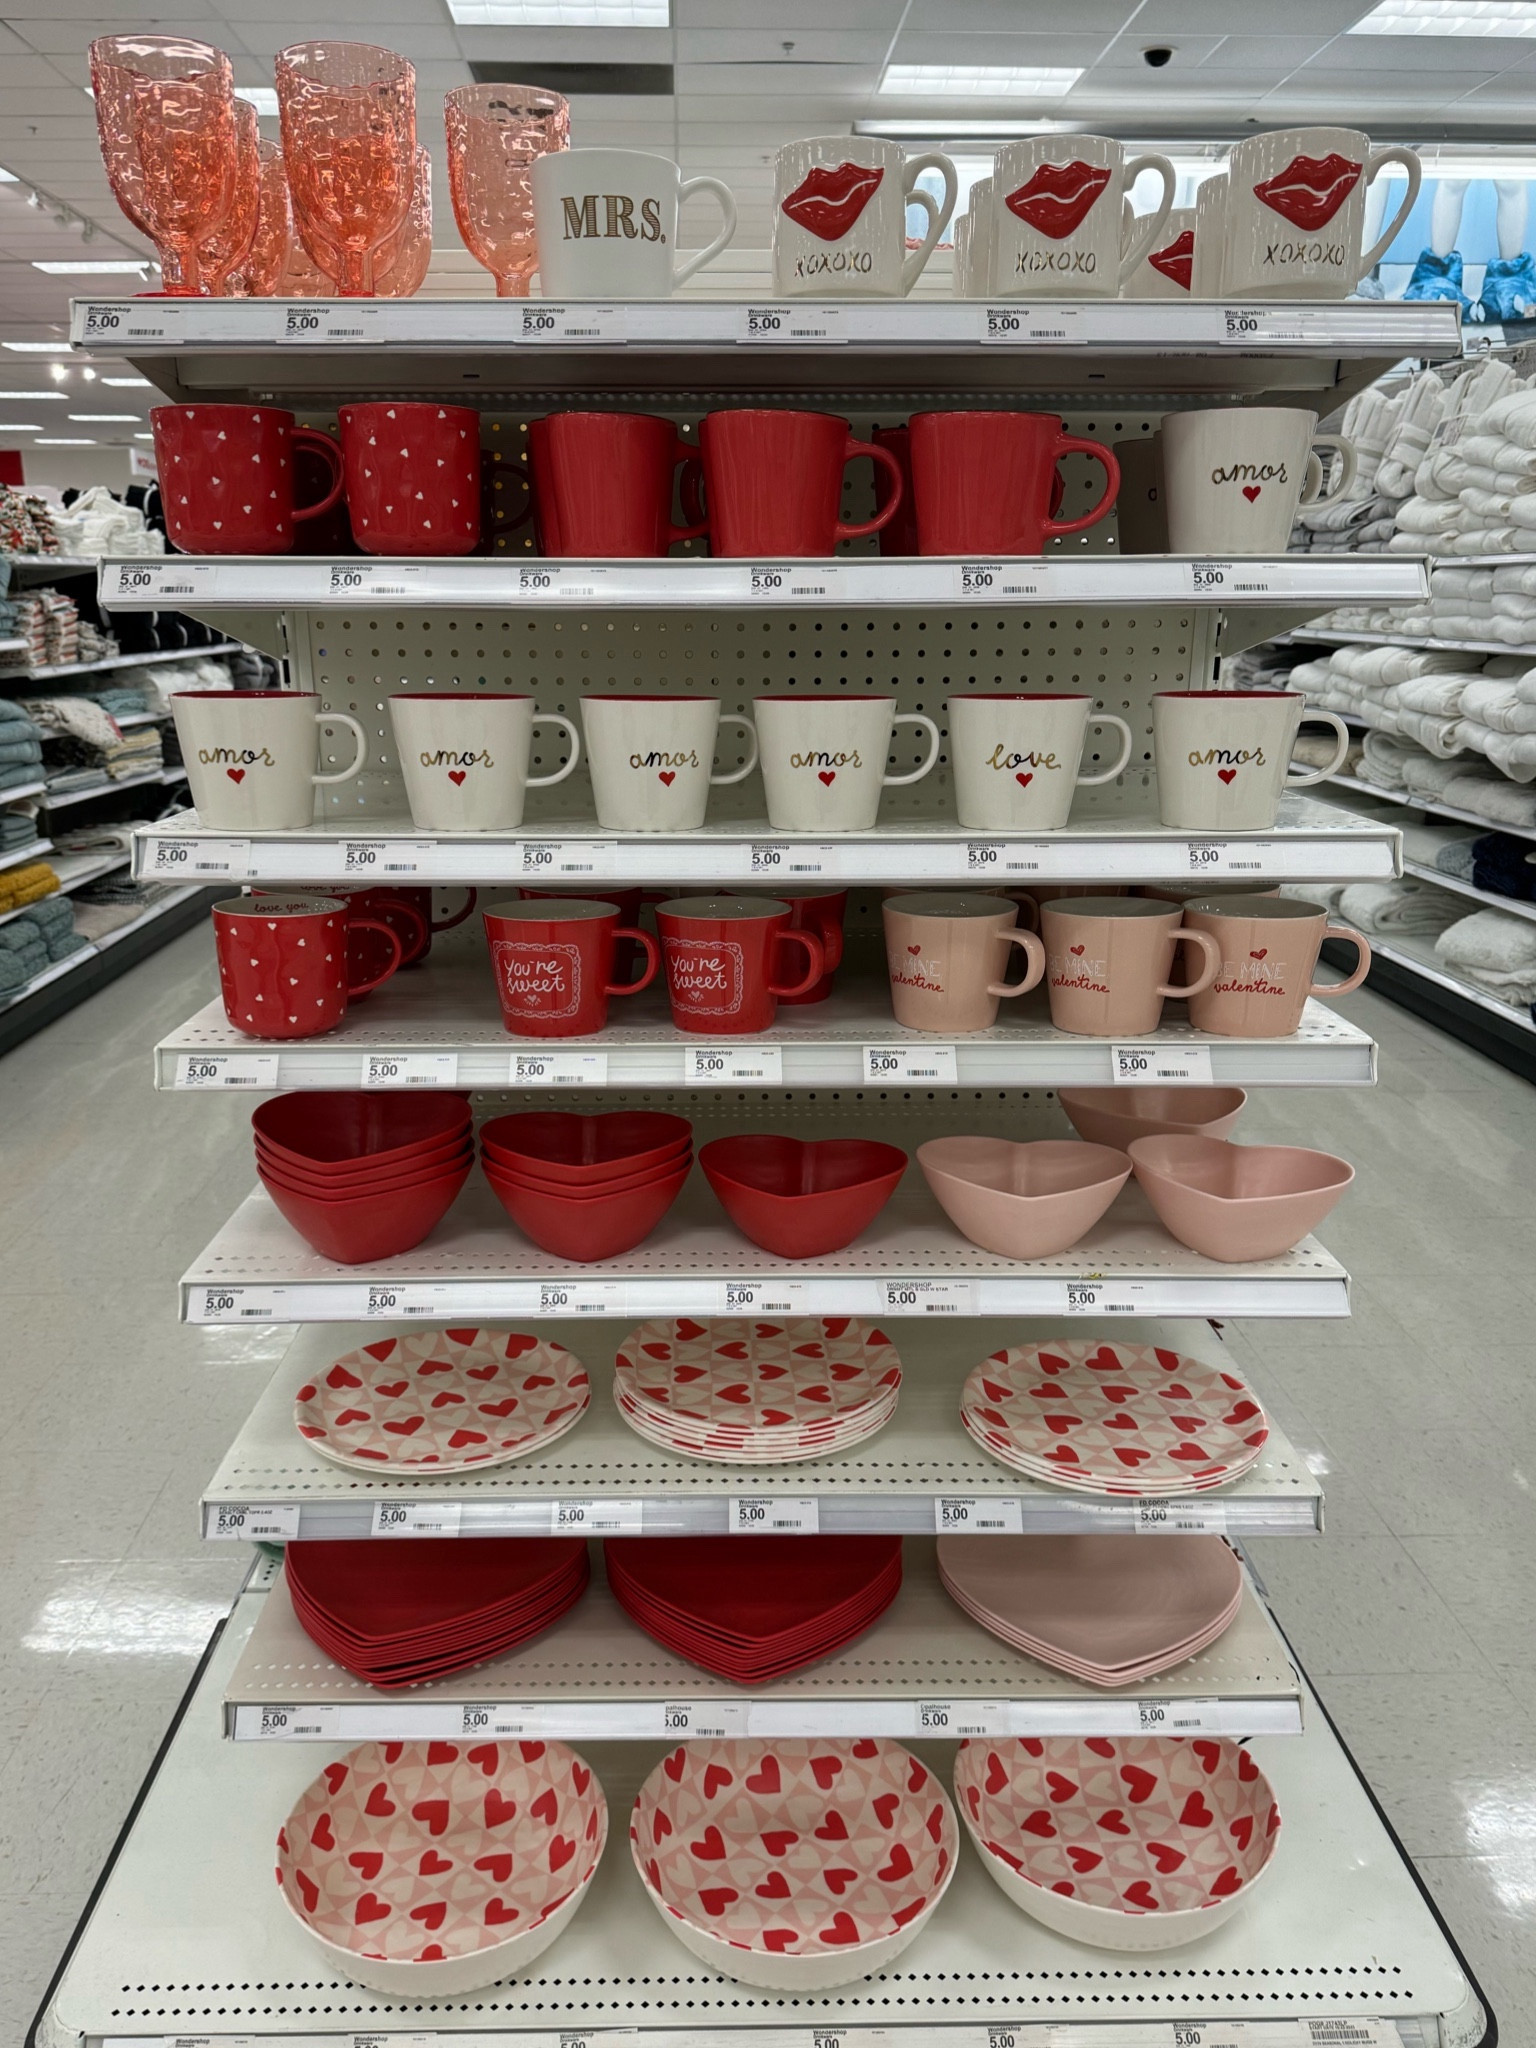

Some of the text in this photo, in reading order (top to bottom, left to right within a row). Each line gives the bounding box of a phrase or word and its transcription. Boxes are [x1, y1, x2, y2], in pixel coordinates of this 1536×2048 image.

[560, 195, 666, 244] MRS.
[1262, 244, 1346, 266] XOXOXO
[794, 252, 872, 277] XOXOXO
[1015, 251, 1096, 273] XOXOXO
[88, 305, 131, 313] Wondershop
[87, 316, 120, 328] 5.00
[287, 317, 319, 329] 5.00
[523, 317, 555, 329] 5.00
[748, 317, 781, 330] 5.00
[988, 318, 1020, 330] 5.00
[1226, 319, 1258, 331] 5.00
[1212, 462, 1288, 484] amor
[120, 573, 151, 585] 5.00
[331, 574, 362, 586] 5.00
[520, 576, 551, 588] 5.00
[751, 575, 782, 587] 5.00
[962, 574, 993, 586] 5.00
[1193, 572, 1224, 584] 5.00
[199, 748, 275, 766] amor
[420, 748, 494, 767] amor
[630, 750, 699, 768] amor
[790, 750, 862, 768] amor
[986, 744, 1062, 769] love
[1190, 747, 1265, 766] amor
[157, 850, 188, 862] 5.00
[346, 852, 377, 864] 5.00
[523, 852, 553, 864] 5.00
[751, 853, 781, 865] 5.00
[968, 851, 997, 862] 5.00
[1189, 851, 1218, 862] 5.00
[254, 903, 283, 913] love
[504, 959, 564, 977] You're
[671, 955, 726, 973] You're
[1065, 957, 1107, 977] MINE
[1240, 961, 1287, 980] MINE
[507, 974, 566, 994] sweet
[674, 971, 728, 989] sweet
[1052, 974, 1110, 992] valentine
[1213, 978, 1286, 995] valentine
[516, 1064, 545, 1075] 5.00
[696, 1058, 724, 1070] 5.00
[870, 1058, 898, 1069] 5.00
[1119, 1058, 1148, 1070] 5.00
[187, 1065, 217, 1077] 5.00
[369, 1065, 398, 1076] 5.00
[206, 1297, 234, 1309] 5.00
[368, 1295, 396, 1307] 5.00
[541, 1293, 568, 1305] 5.00
[726, 1291, 754, 1303] 5.00
[887, 1292, 917, 1304] 5.00
[1068, 1292, 1096, 1304] 5.00
[380, 1510, 407, 1522] 5.00
[558, 1509, 585, 1521] 5.00
[739, 1508, 765, 1520] 5.00
[942, 1508, 968, 1520] 5.00
[1140, 1509, 1167, 1521] 5.00
[218, 1515, 245, 1527] 5.00
[261, 1714, 288, 1727] 5.00
[462, 1713, 488, 1725] 5.00
[922, 1713, 949, 1726] 5.00
[1140, 1709, 1165, 1721] 5.00
[989, 2035, 1015, 2048] 5.00
[1175, 2032, 1201, 2044] 5.00
